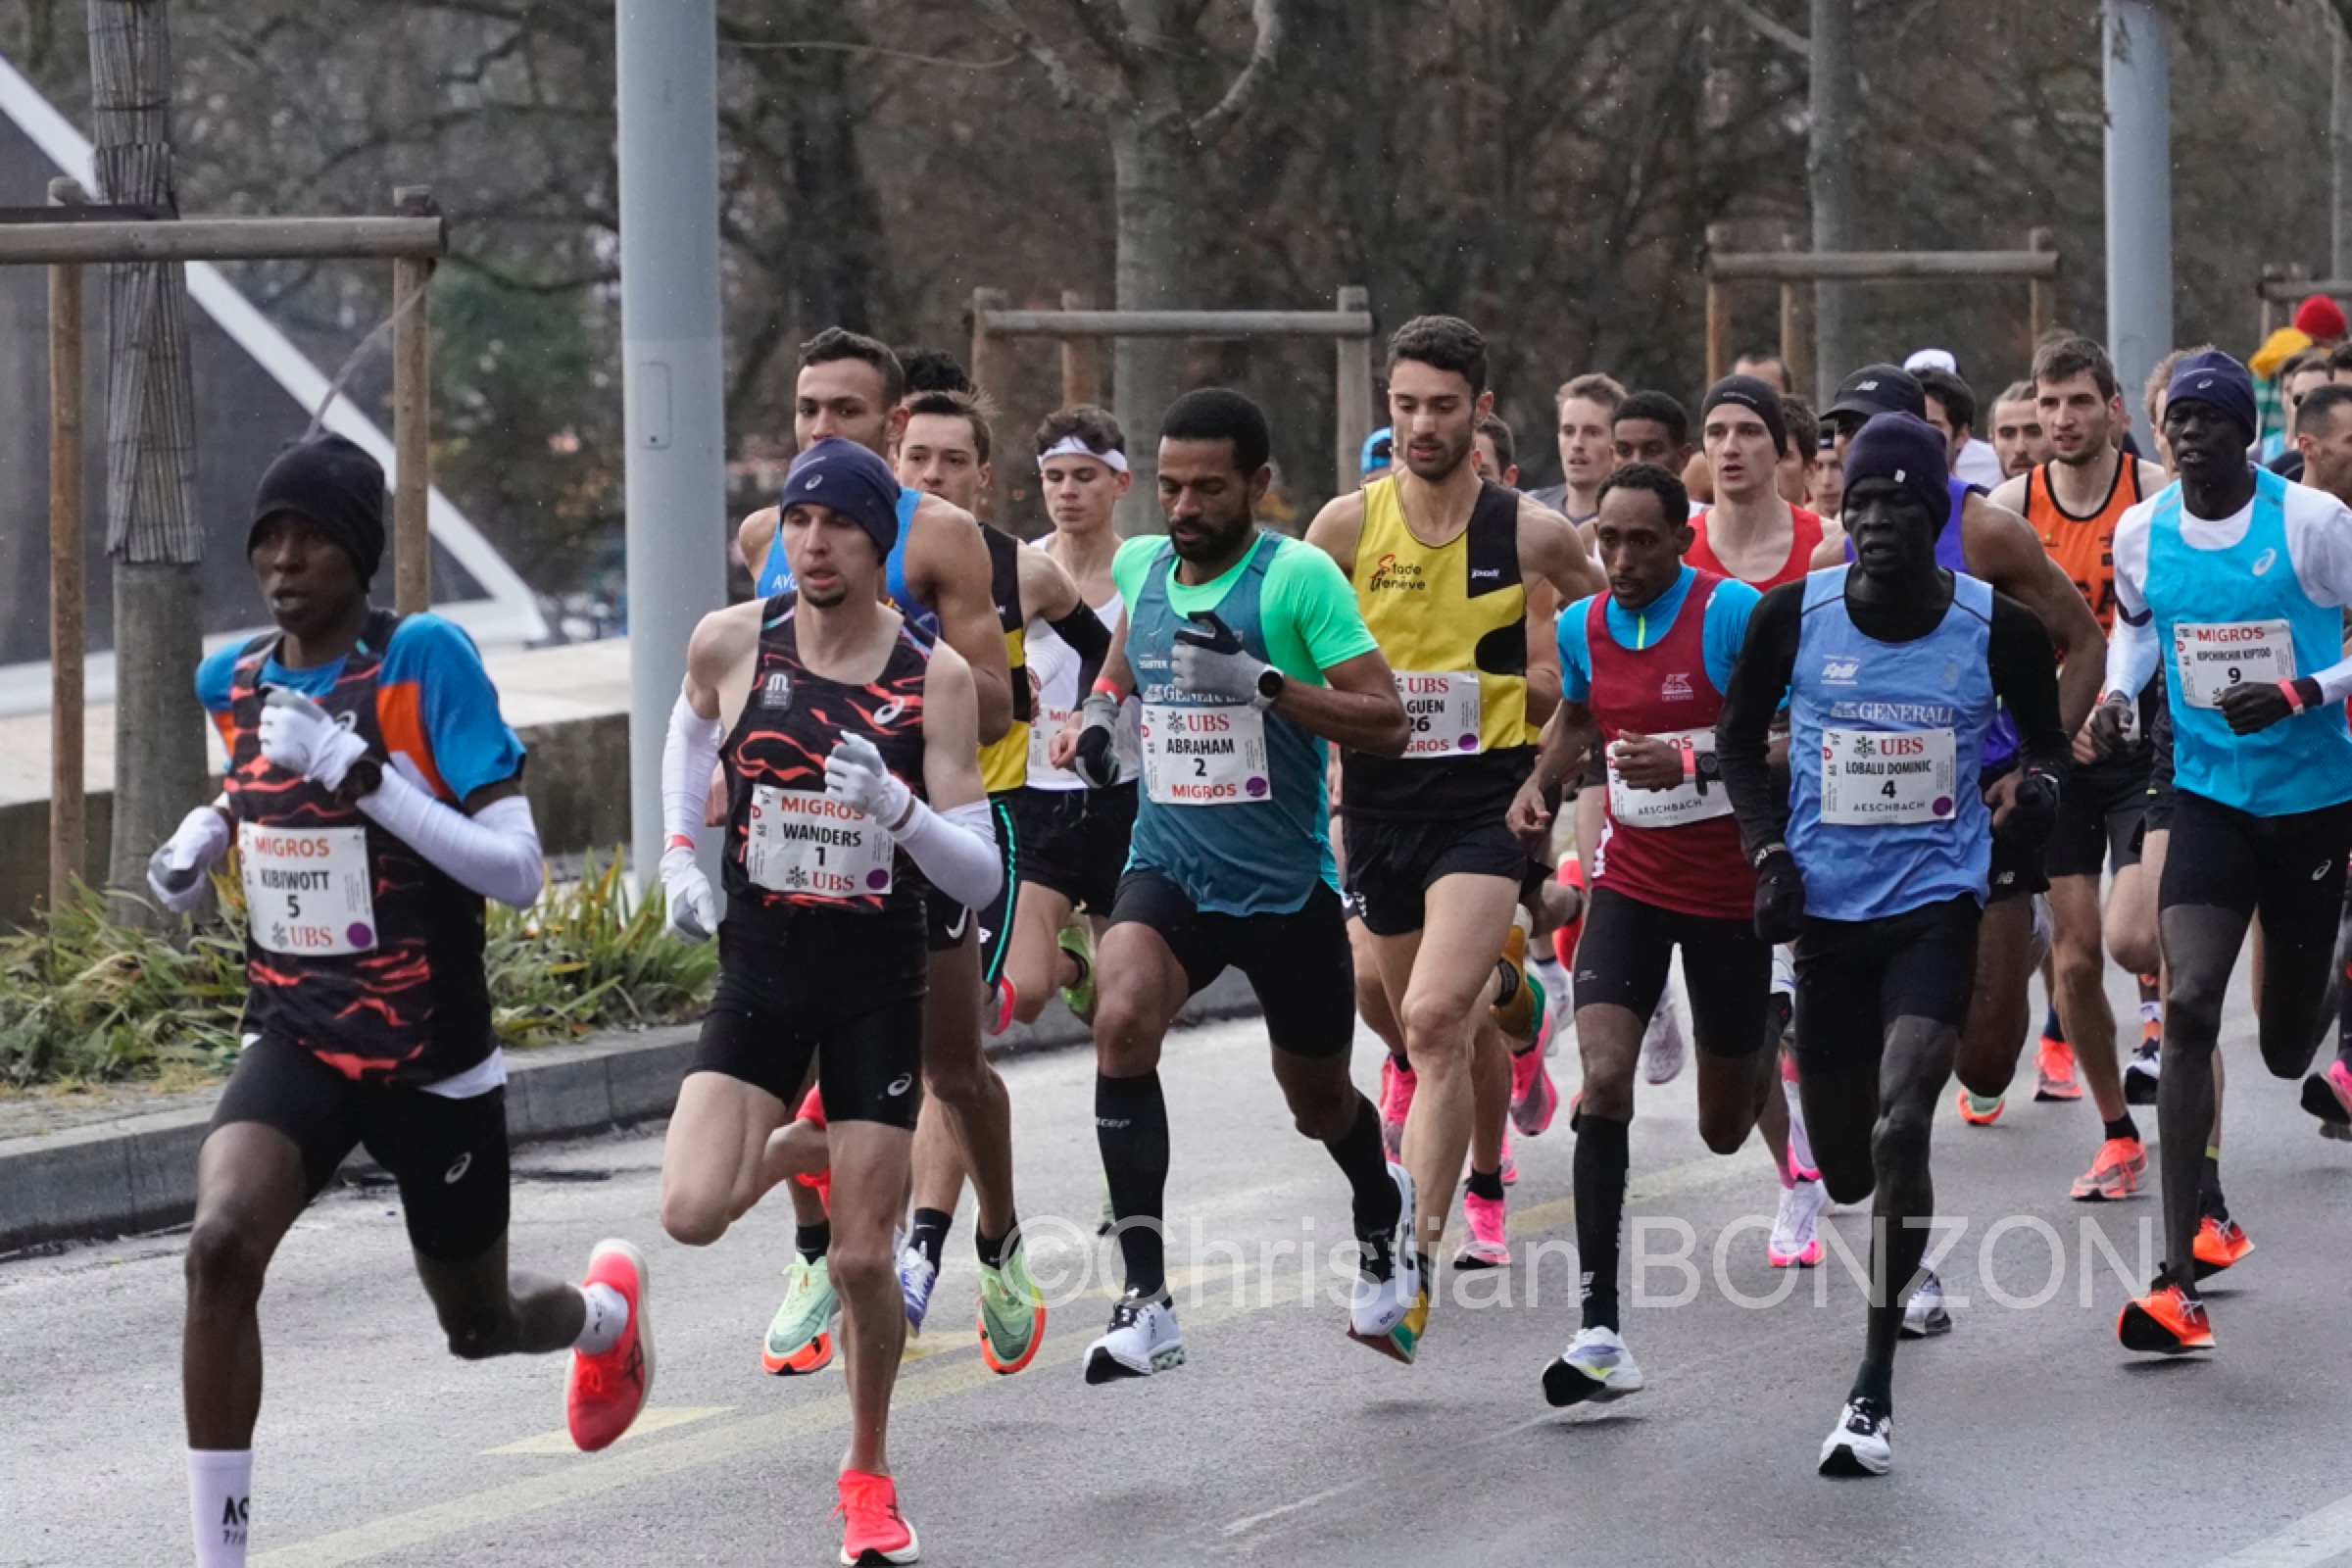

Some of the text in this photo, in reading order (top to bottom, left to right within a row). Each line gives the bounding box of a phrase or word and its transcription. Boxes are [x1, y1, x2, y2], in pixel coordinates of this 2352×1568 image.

[2196, 626, 2265, 642] MIGROS
[2228, 666, 2241, 684] 9
[1408, 677, 1450, 695] UBS
[1406, 699, 1446, 714] GUEN
[1859, 702, 1954, 724] GENERALI
[1187, 713, 1231, 733] UBS
[1166, 738, 1236, 755] ABRAHAM
[1880, 737, 1925, 757] UBS
[1193, 758, 1207, 777] 2
[1845, 760, 1932, 775] LOBALU DOMINIC
[1171, 783, 1238, 799] MIGROS
[1881, 779, 1897, 799] 4
[1638, 799, 1702, 816] AESCHBACH
[1853, 801, 1926, 812] AESCHBACH
[783, 822, 862, 848] WANDERS
[255, 836, 330, 858] MIGROS
[814, 846, 826, 867] 1
[260, 868, 330, 892] KIBIWOTT
[812, 870, 857, 892] UBS
[287, 893, 301, 918] 5
[290, 925, 333, 948] UBS
